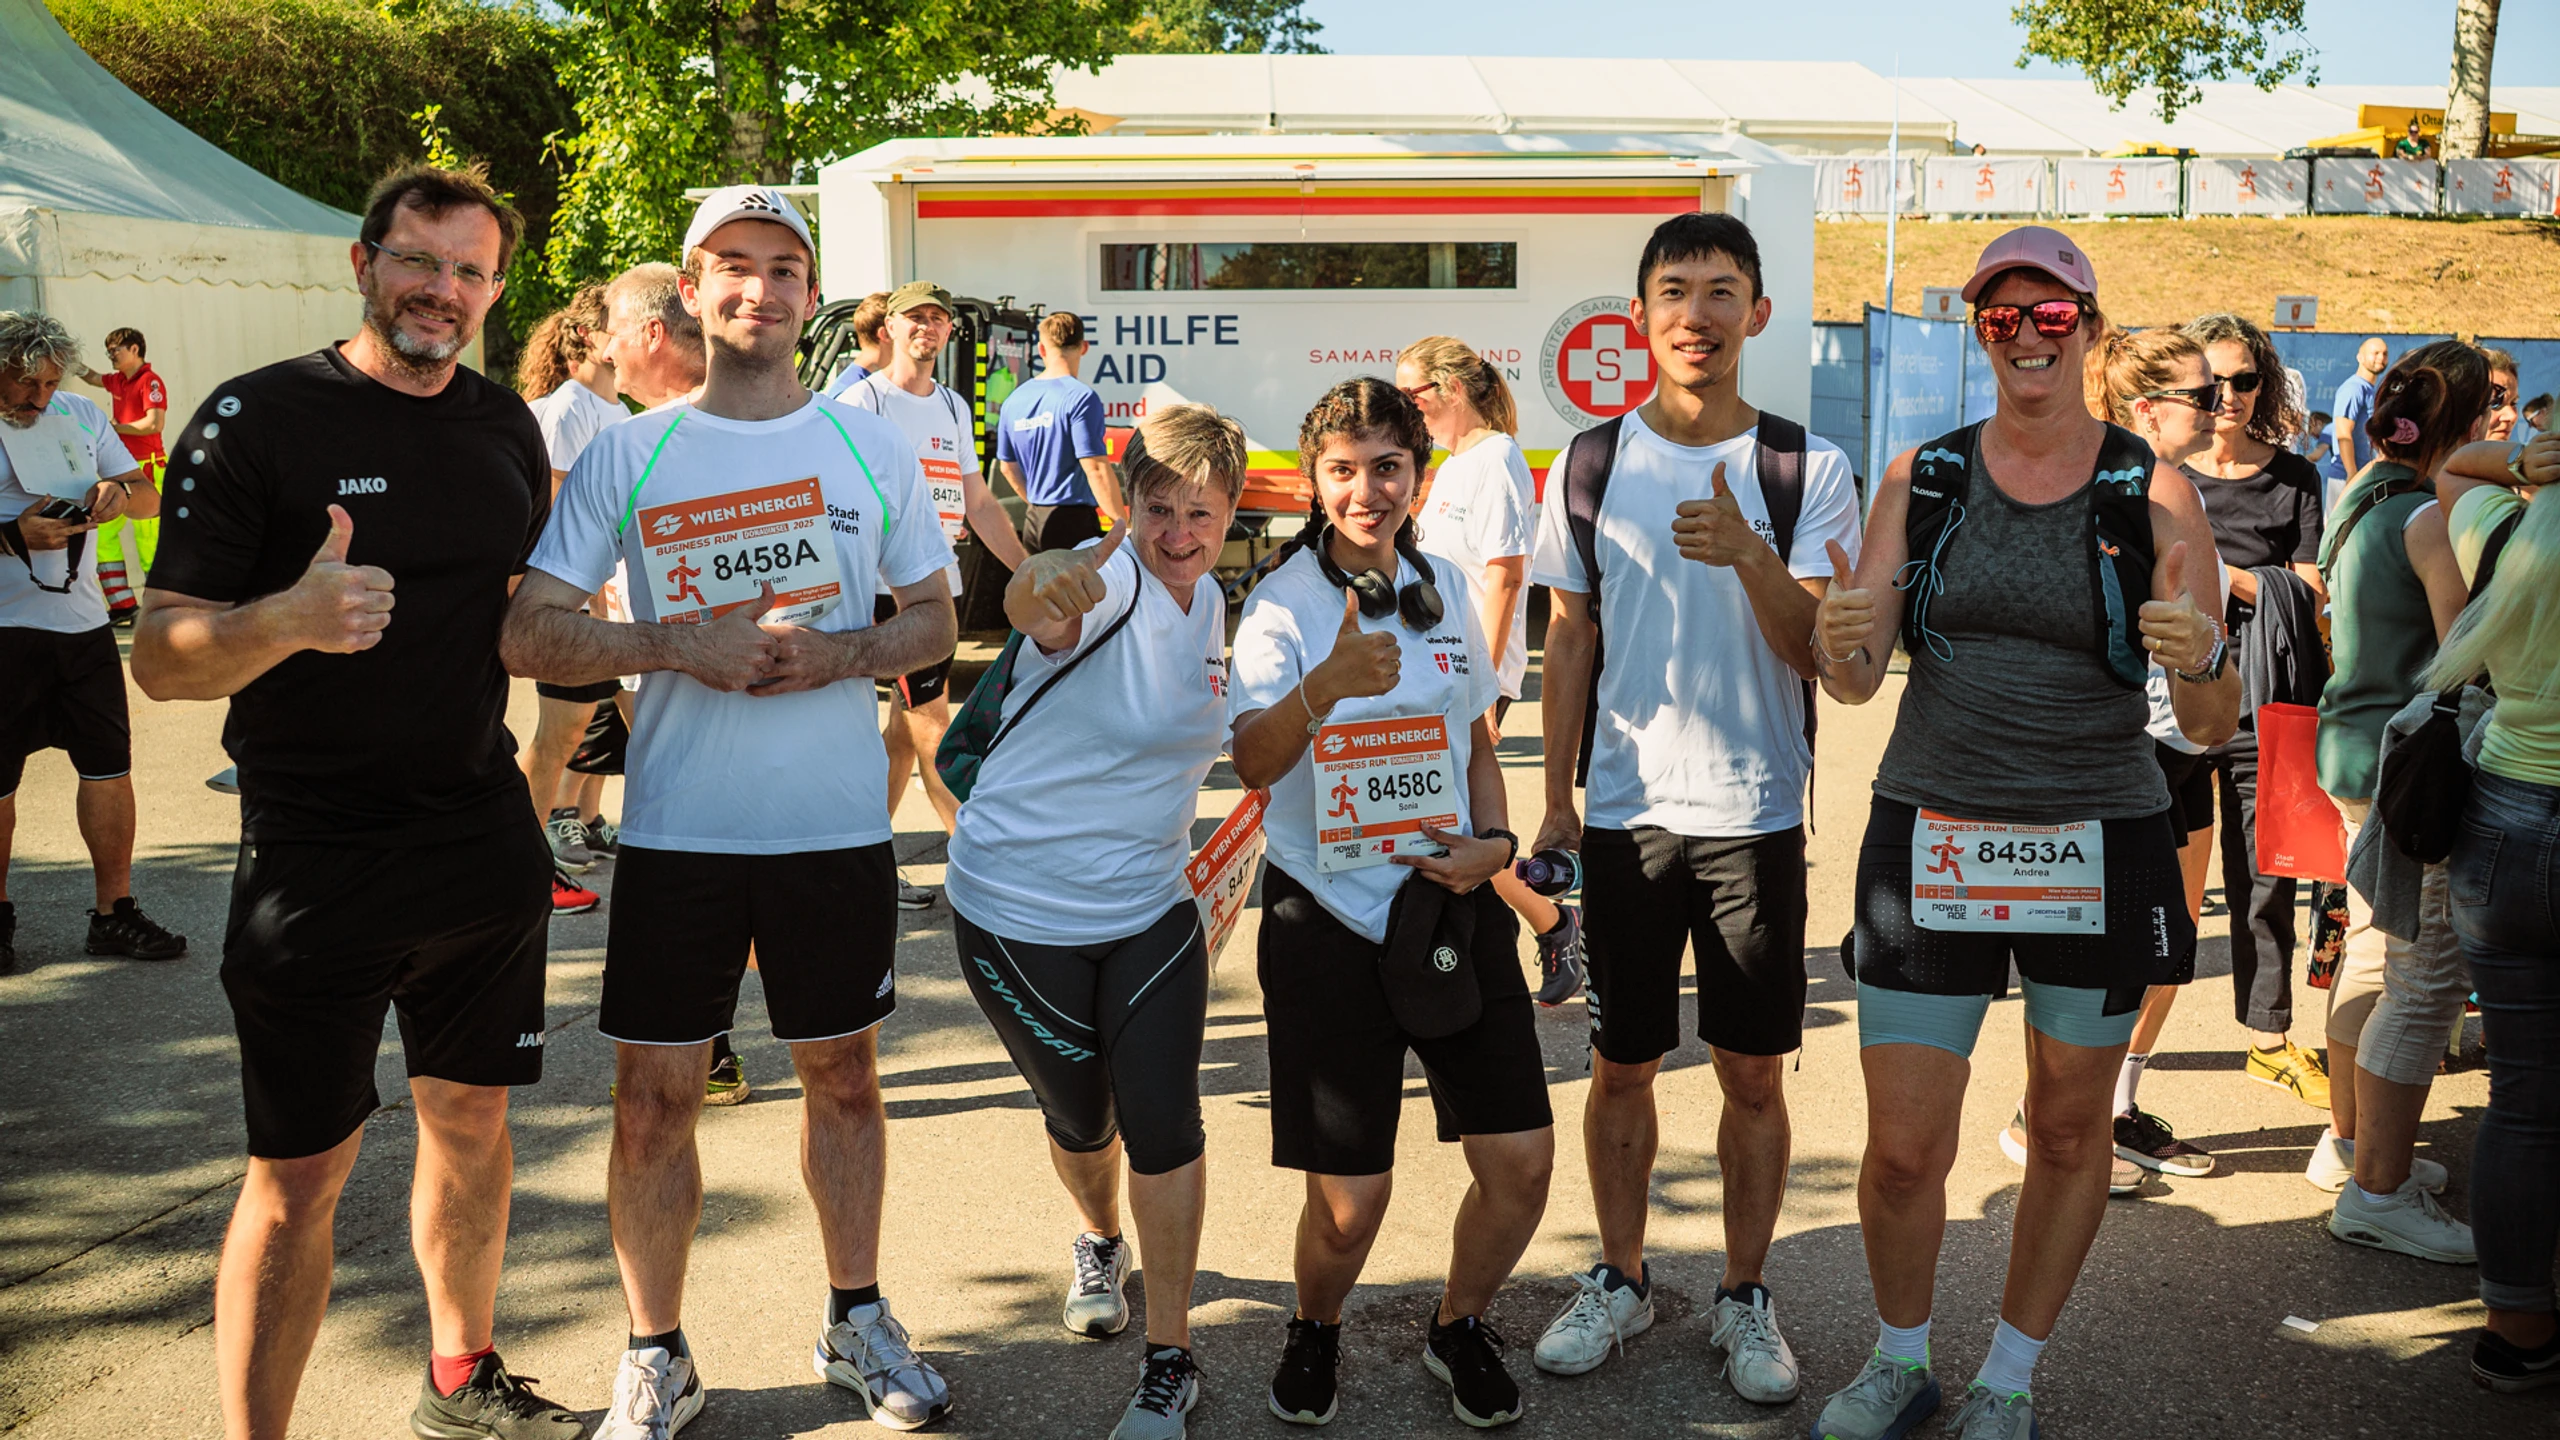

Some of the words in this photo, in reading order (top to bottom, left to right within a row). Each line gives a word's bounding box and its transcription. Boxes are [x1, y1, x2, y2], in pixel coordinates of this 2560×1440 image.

[1115, 315, 1240, 345] HILFE
[1543, 317, 1573, 389] ARBEITER
[1093, 354, 1166, 384] AID
[1596, 348, 1621, 381] S
[337, 477, 387, 495] JAKO
[689, 506, 737, 526] WIEN
[739, 492, 813, 517] ENERGIE
[827, 504, 860, 521] Stadt
[829, 520, 859, 536] Wien
[1754, 519, 1774, 531] Sta
[656, 536, 711, 556] BUSINESS
[714, 533, 738, 545] RUN
[793, 519, 815, 531] 2025
[713, 538, 820, 581] 8458A
[1351, 733, 1386, 748] WIEN
[1390, 728, 1441, 744] ENERGIE
[1324, 761, 1367, 773] BUSINESS
[1369, 759, 1387, 767] RUN
[1427, 753, 1441, 761] 2025
[1367, 770, 1443, 802] 8458C
[1399, 802, 1419, 811] Sonia
[1210, 836, 1232, 863] WIEN
[1231, 800, 1262, 839] ENERGIE
[1927, 822, 1980, 832] BUSINESS
[2064, 823, 2086, 832] 2025
[1334, 843, 1361, 854] POWER
[1977, 841, 2086, 864] 8453A
[2275, 853, 2295, 861] Stadt
[2013, 868, 2050, 877] Andrea
[2274, 859, 2294, 868] Wien
[1932, 903, 1967, 911] POWER
[1980, 908, 1992, 916] AK
[2158, 906, 2169, 957] SALOMON
[972, 956, 1096, 1062] DYNAFIT
